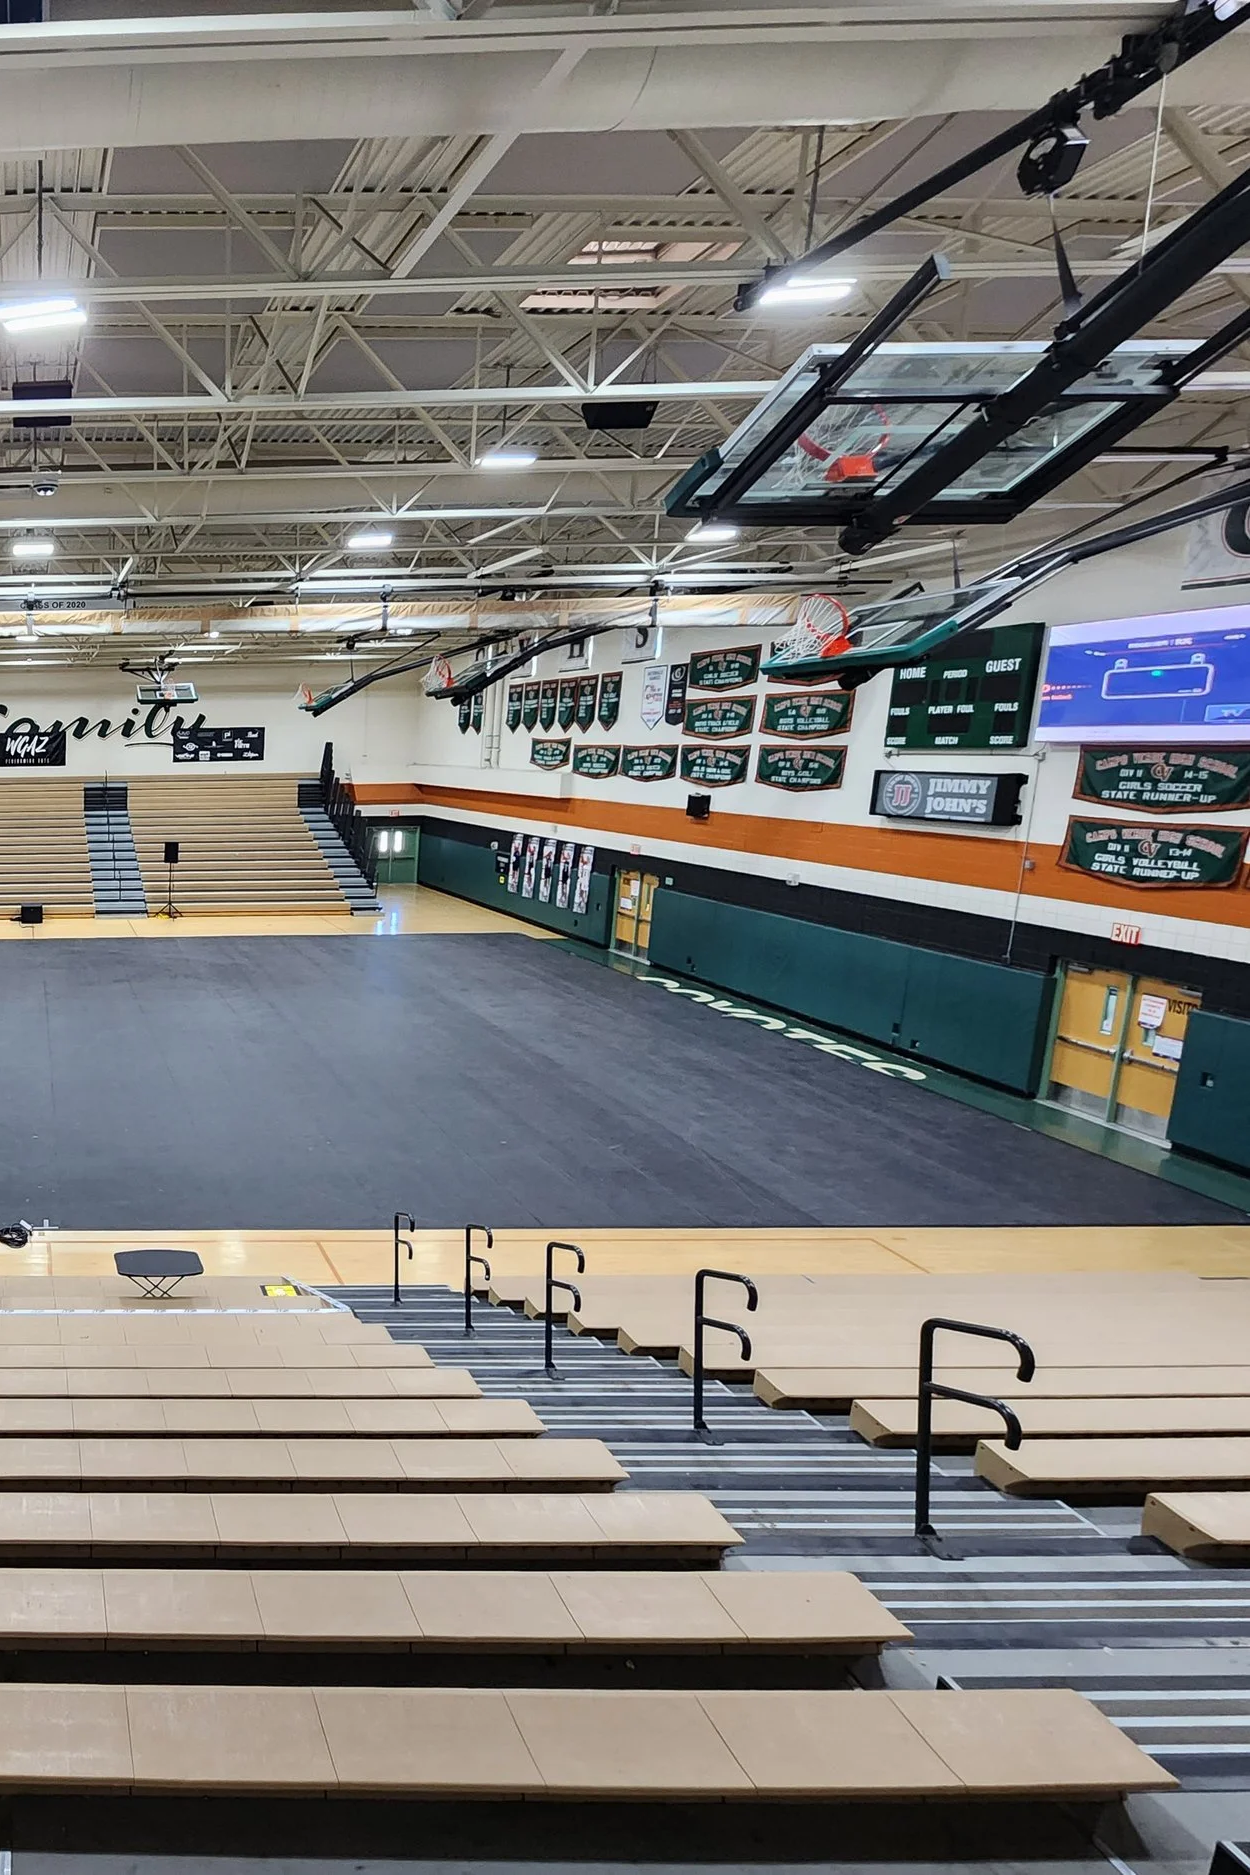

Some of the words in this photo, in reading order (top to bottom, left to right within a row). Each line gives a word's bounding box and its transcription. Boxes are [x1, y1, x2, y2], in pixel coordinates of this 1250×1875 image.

[20, 601, 49, 610] CASS
[52, 601, 64, 609] OF
[66, 601, 86, 609] 2020
[900, 667, 927, 680] HOME
[943, 669, 968, 679] PERIOD
[985, 658, 1022, 673] GUEST
[890, 707, 910, 716] FOULS
[928, 705, 953, 714] PLAYER
[956, 704, 975, 713] FOUL
[994, 702, 1019, 712] FOULS
[5, 735, 49, 758] WGAZ
[886, 736, 907, 745] SCORE
[934, 736, 959, 745] MATCH
[989, 735, 1014, 745] SCORE
[1095, 754, 1129, 771] CAMPO
[1183, 770, 1210, 779] 14-15
[927, 778, 992, 796] JIMMY
[1118, 781, 1152, 790] GIRLS
[1157, 782, 1203, 792] SOCCER
[891, 784, 913, 807] JJ
[1101, 790, 1137, 800] STATE
[1142, 791, 1218, 803] RUNNER-UP
[924, 796, 987, 814] JOHN'S
[1094, 853, 1126, 864] GIRLS
[1168, 848, 1193, 857] 13-14
[1091, 862, 1127, 875] STATE
[1132, 866, 1200, 880] RUNNER-UP
[1112, 923, 1139, 945] EXIT
